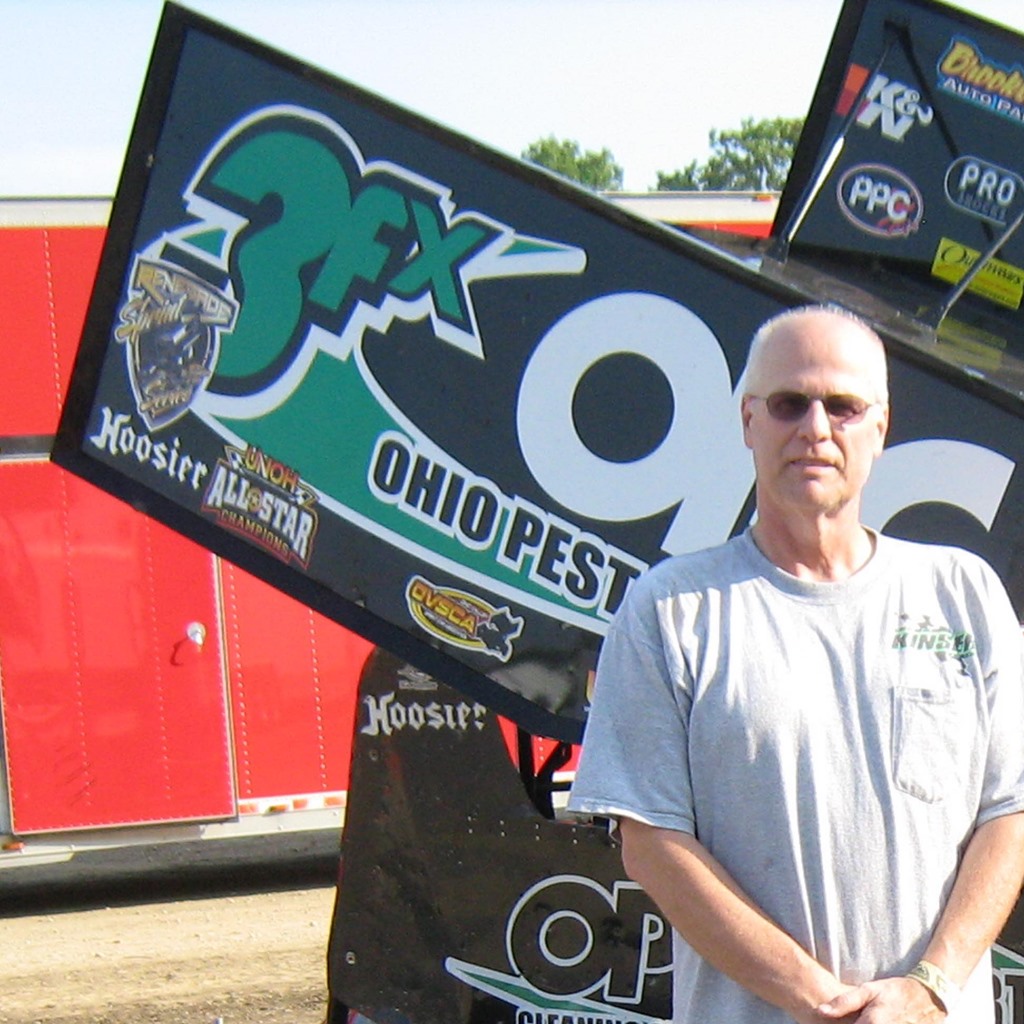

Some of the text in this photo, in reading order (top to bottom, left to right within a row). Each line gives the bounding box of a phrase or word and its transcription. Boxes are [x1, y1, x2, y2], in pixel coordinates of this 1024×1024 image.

[848, 173, 912, 222] PPC
[958, 162, 1015, 206] PRO
[89, 405, 210, 492] Hoosier
[245, 443, 300, 493] UNOH
[206, 465, 315, 560] ALL STAR
[372, 437, 643, 616] OHIO PEST
[411, 580, 479, 635] OVSCA
[361, 691, 487, 737] Hoosier
